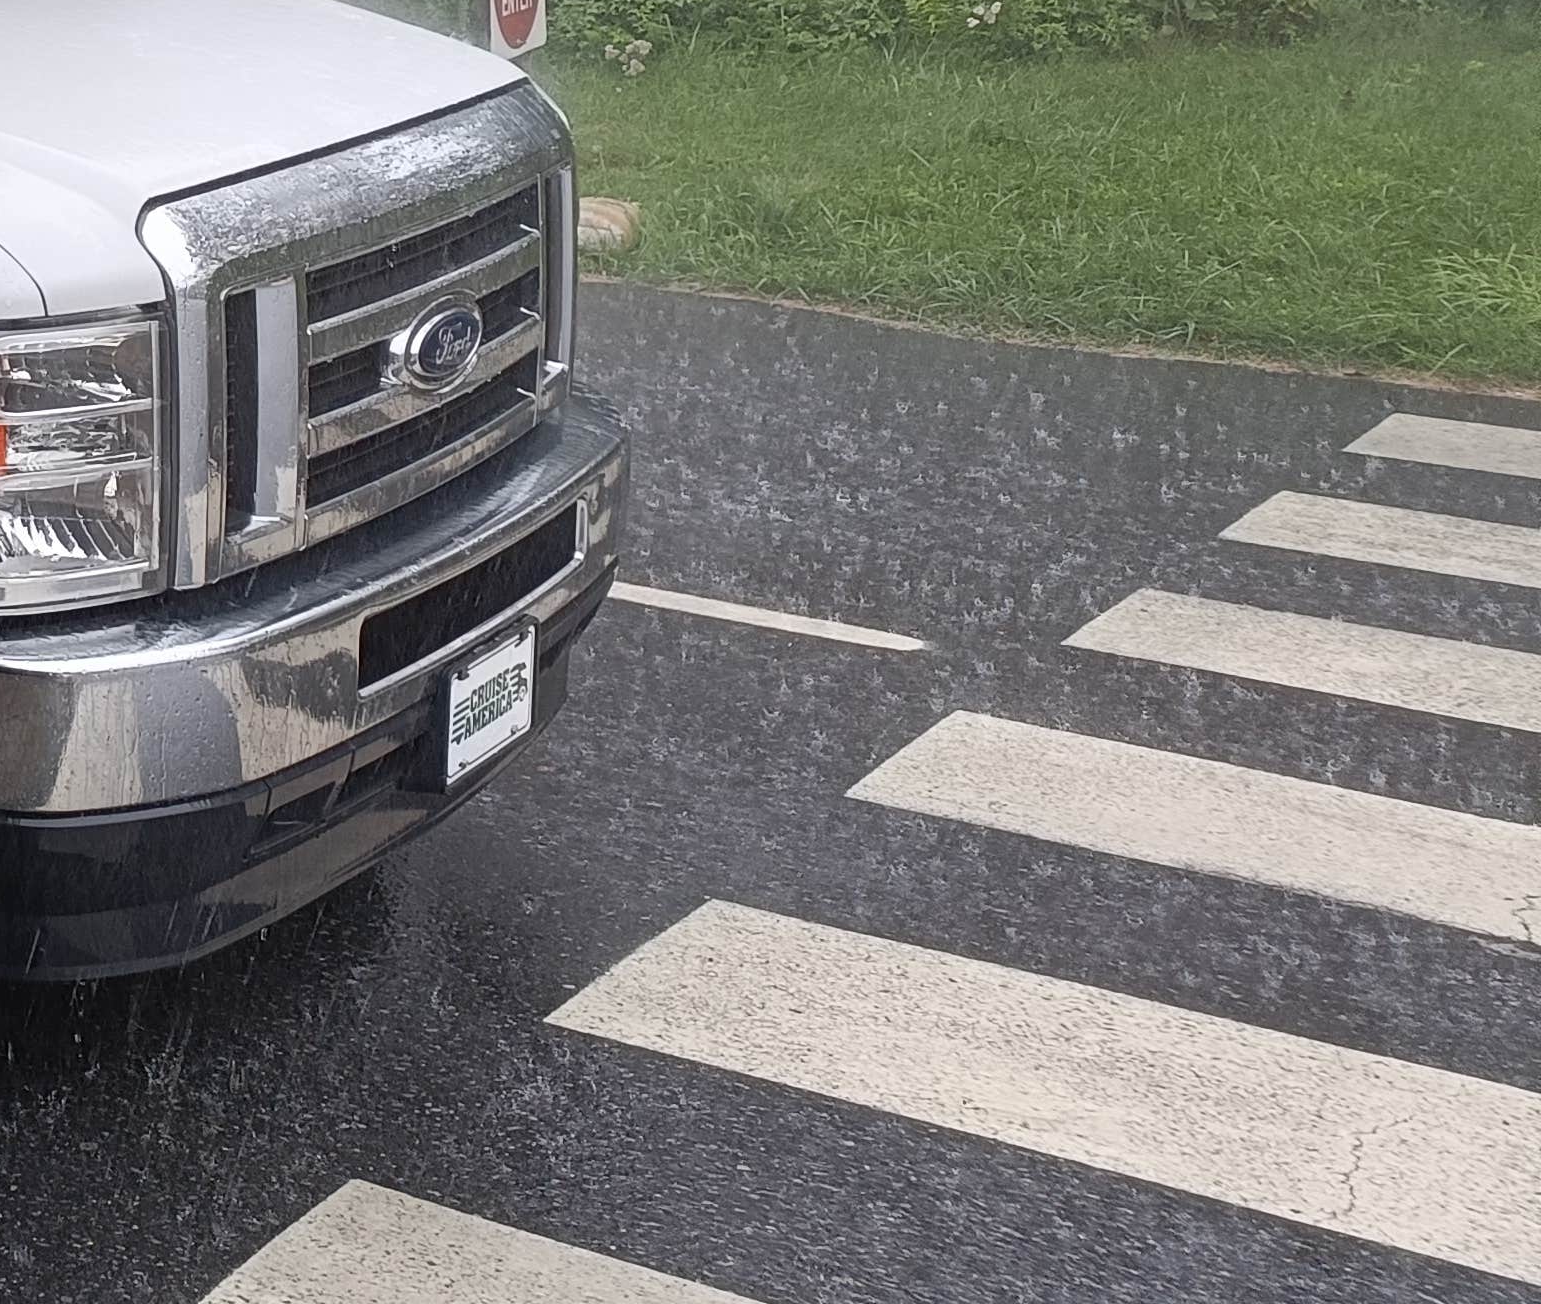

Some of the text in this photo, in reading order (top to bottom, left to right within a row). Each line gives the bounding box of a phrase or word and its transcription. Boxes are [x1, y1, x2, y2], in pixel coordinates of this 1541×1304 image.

[436, 321, 472, 365] Ford
[471, 669, 510, 713] CRUISE
[464, 690, 513, 740] AMERICA
